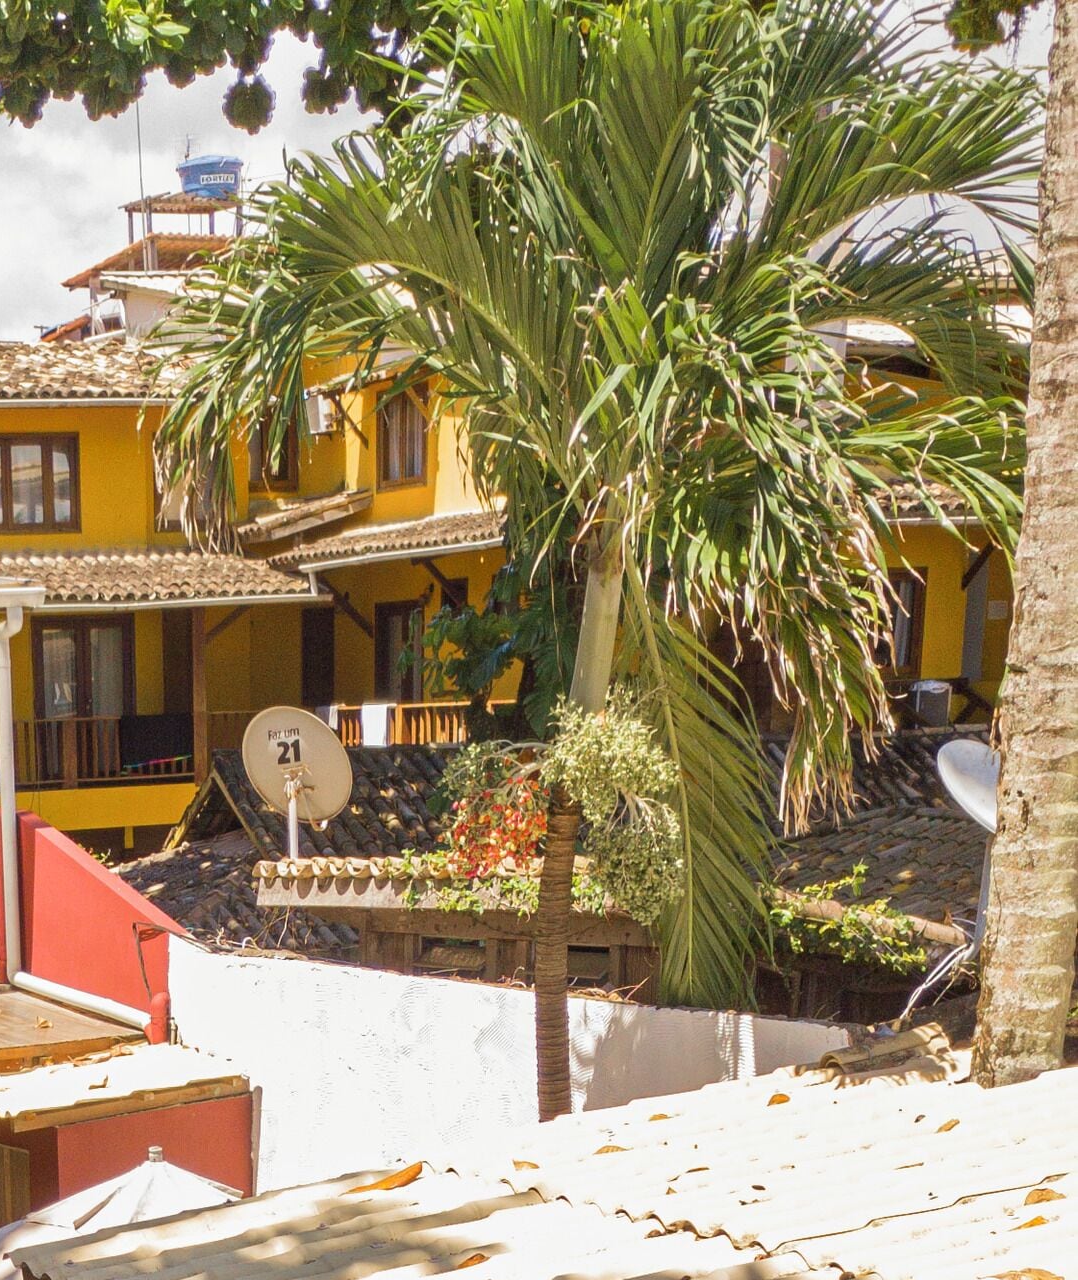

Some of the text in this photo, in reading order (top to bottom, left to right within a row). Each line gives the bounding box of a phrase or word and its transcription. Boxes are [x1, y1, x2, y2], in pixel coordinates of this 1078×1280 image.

[268, 728, 300, 741] Faz um
[277, 739, 301, 765] 21
